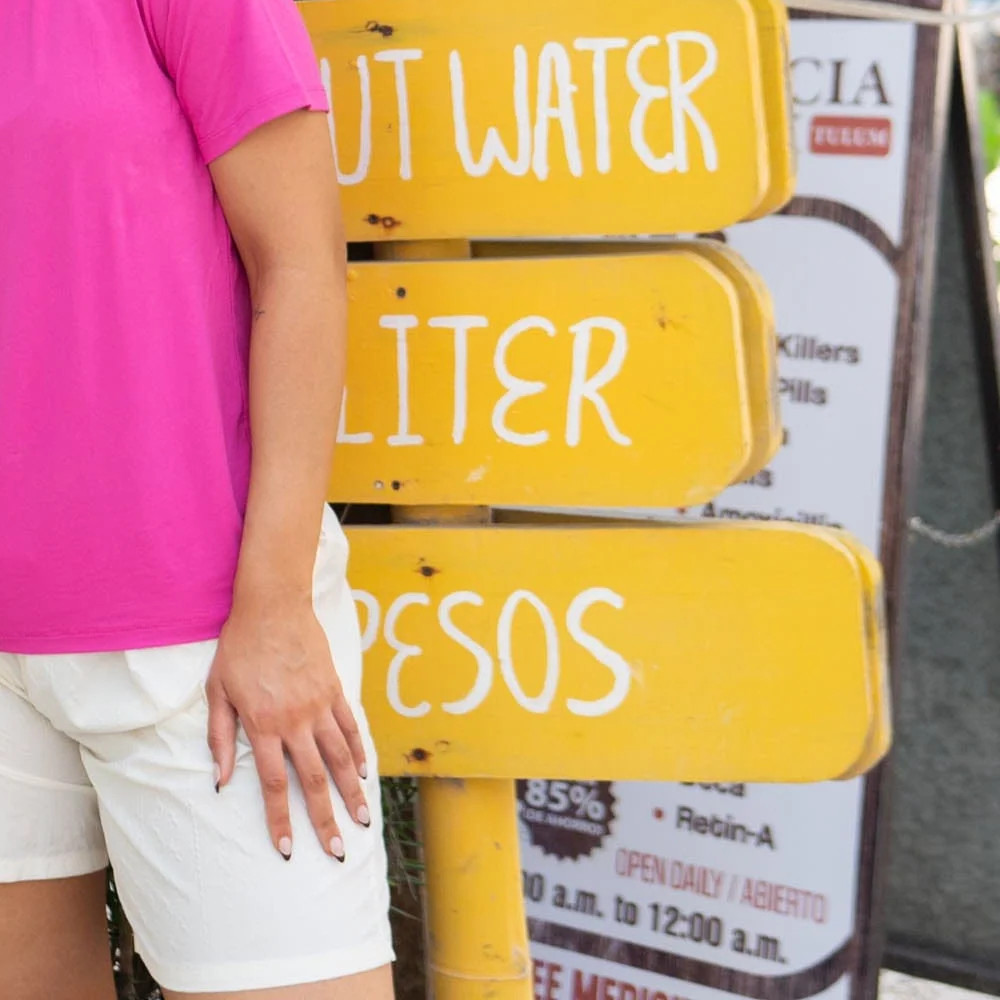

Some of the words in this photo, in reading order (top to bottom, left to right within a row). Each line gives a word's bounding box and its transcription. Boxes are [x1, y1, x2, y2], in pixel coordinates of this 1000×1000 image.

[321, 48, 424, 186] UT
[449, 31, 719, 181] WATER
[776, 334, 861, 364] Killers
[676, 805, 776, 850] Retin-A
[553, 884, 603, 917] a.m.
[614, 895, 638, 926] to
[650, 903, 723, 948] 12:00
[731, 928, 788, 964] a.m.
[614, 848, 667, 886] OPEN
[669, 860, 723, 898] DAILY
[741, 877, 829, 925] ABIERTO
